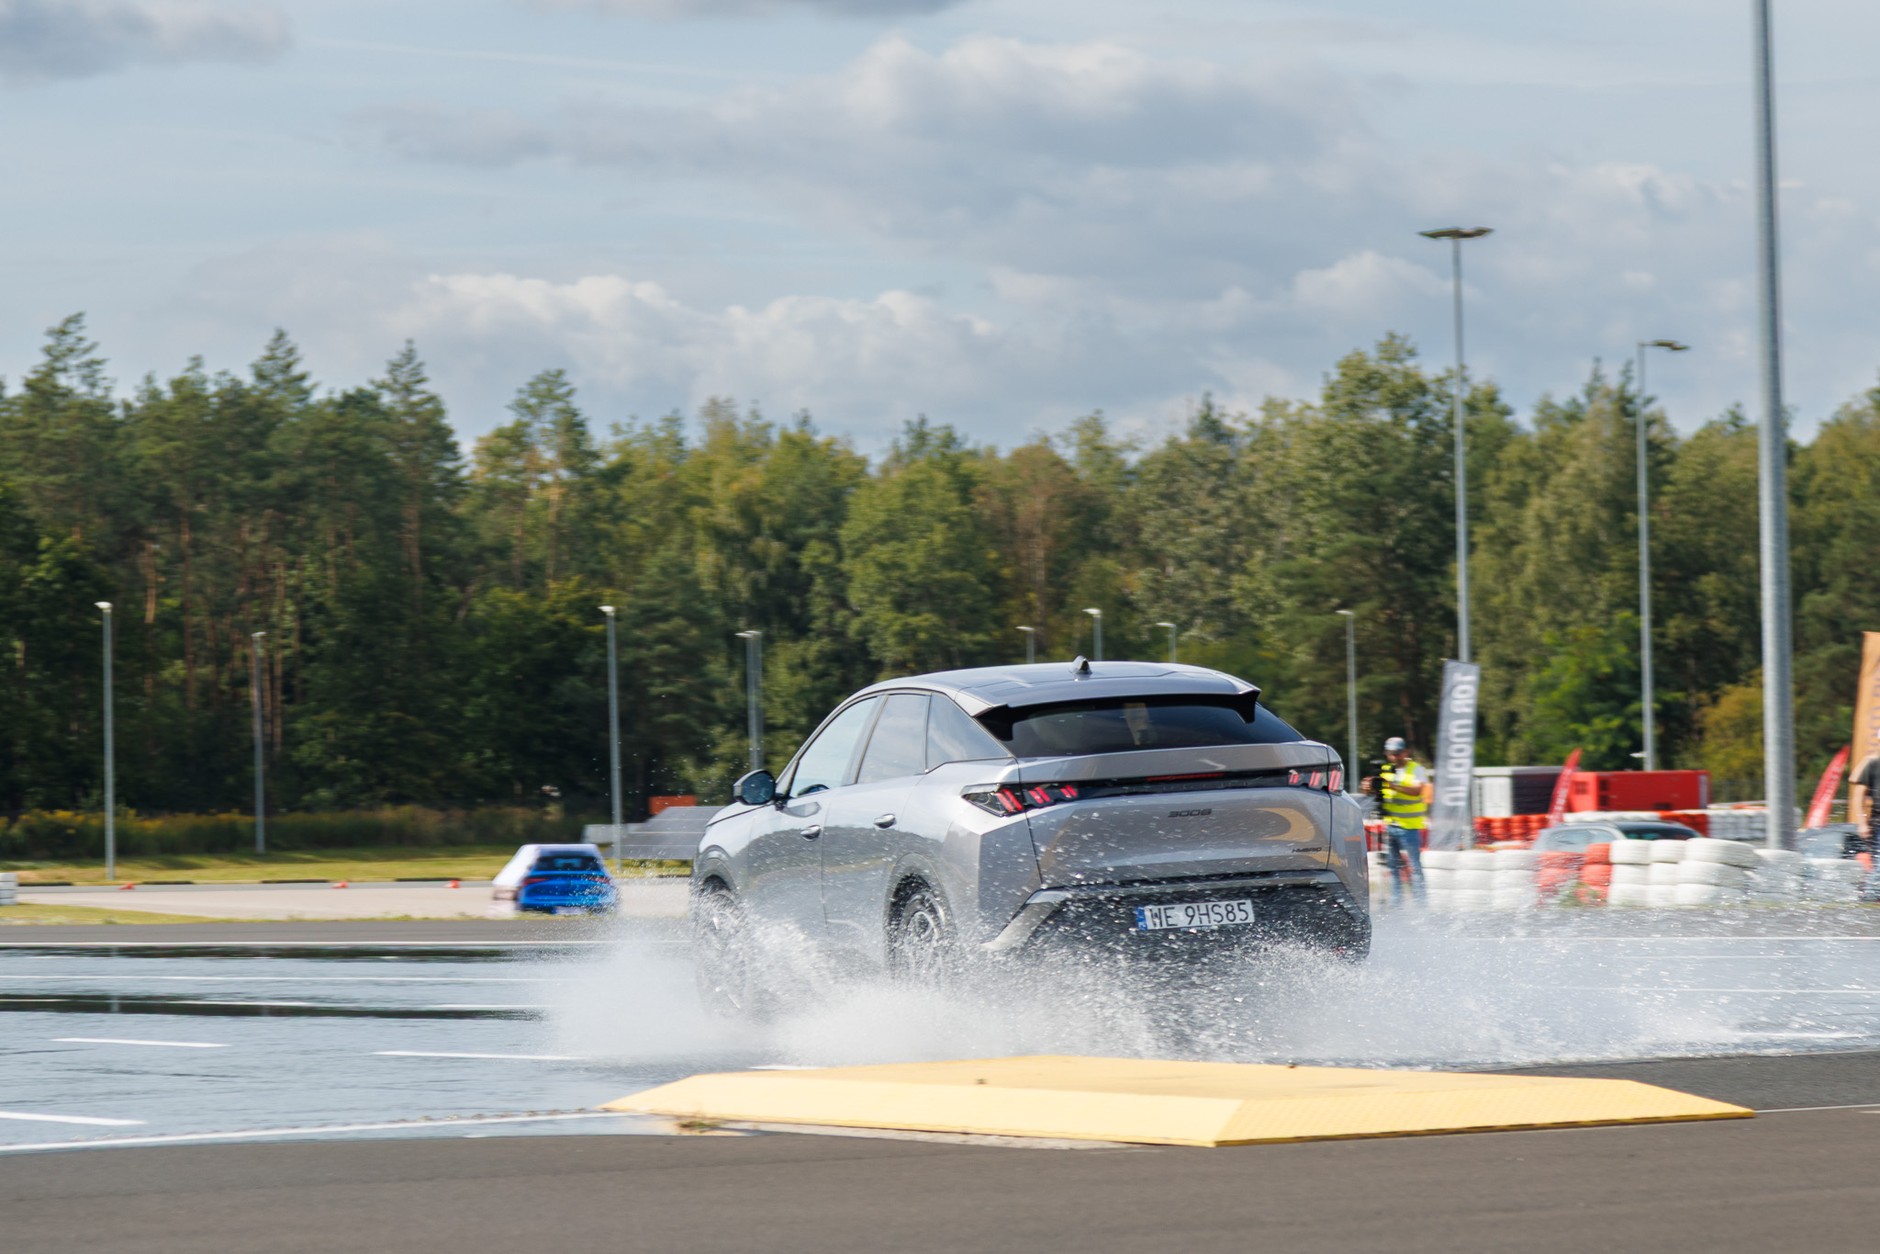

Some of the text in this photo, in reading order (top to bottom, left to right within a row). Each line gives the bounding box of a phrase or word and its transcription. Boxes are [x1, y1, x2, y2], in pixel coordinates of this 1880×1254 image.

[1168, 808, 1213, 818] 3008
[1149, 902, 1249, 928] WE 9HS85
